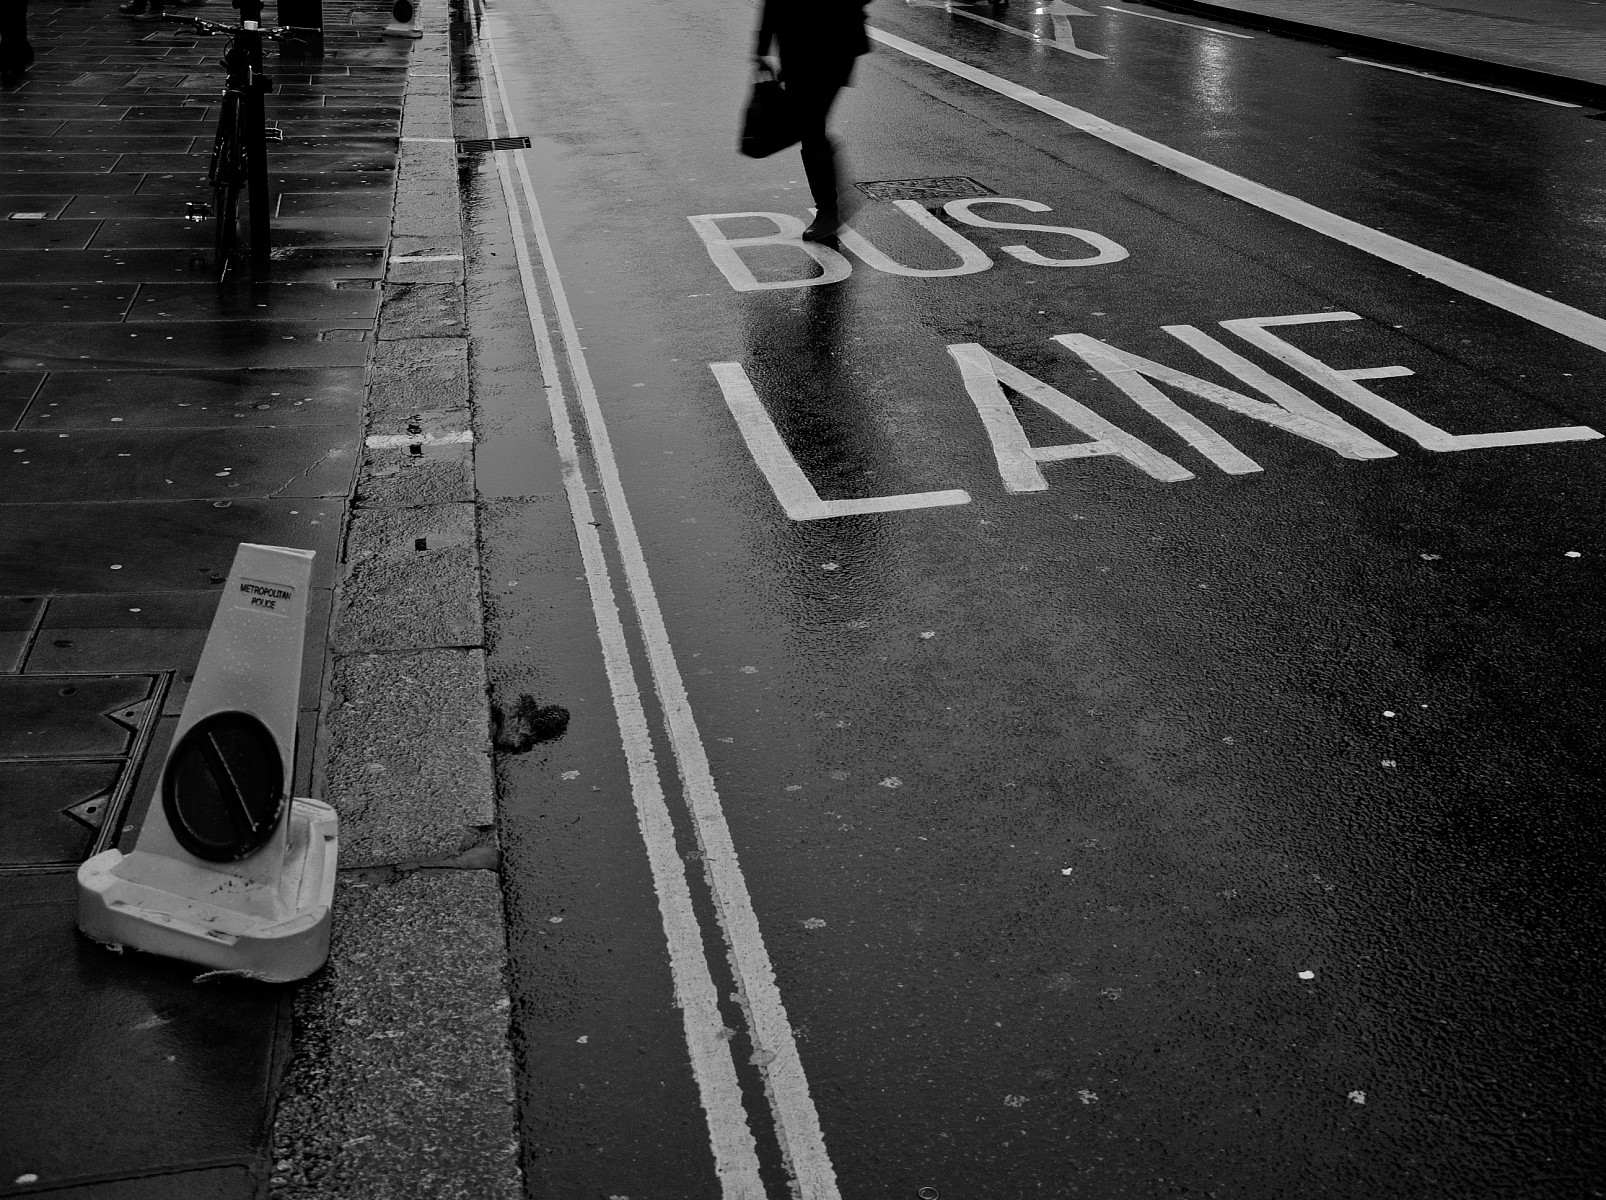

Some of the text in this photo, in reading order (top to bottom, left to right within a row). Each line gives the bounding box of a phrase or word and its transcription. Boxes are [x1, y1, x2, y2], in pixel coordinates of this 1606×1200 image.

[687, 197, 1131, 293] BUS
[709, 311, 1602, 521] LANE
[240, 583, 292, 600] METROPOLITAN
[251, 597, 276, 610] POLICE
